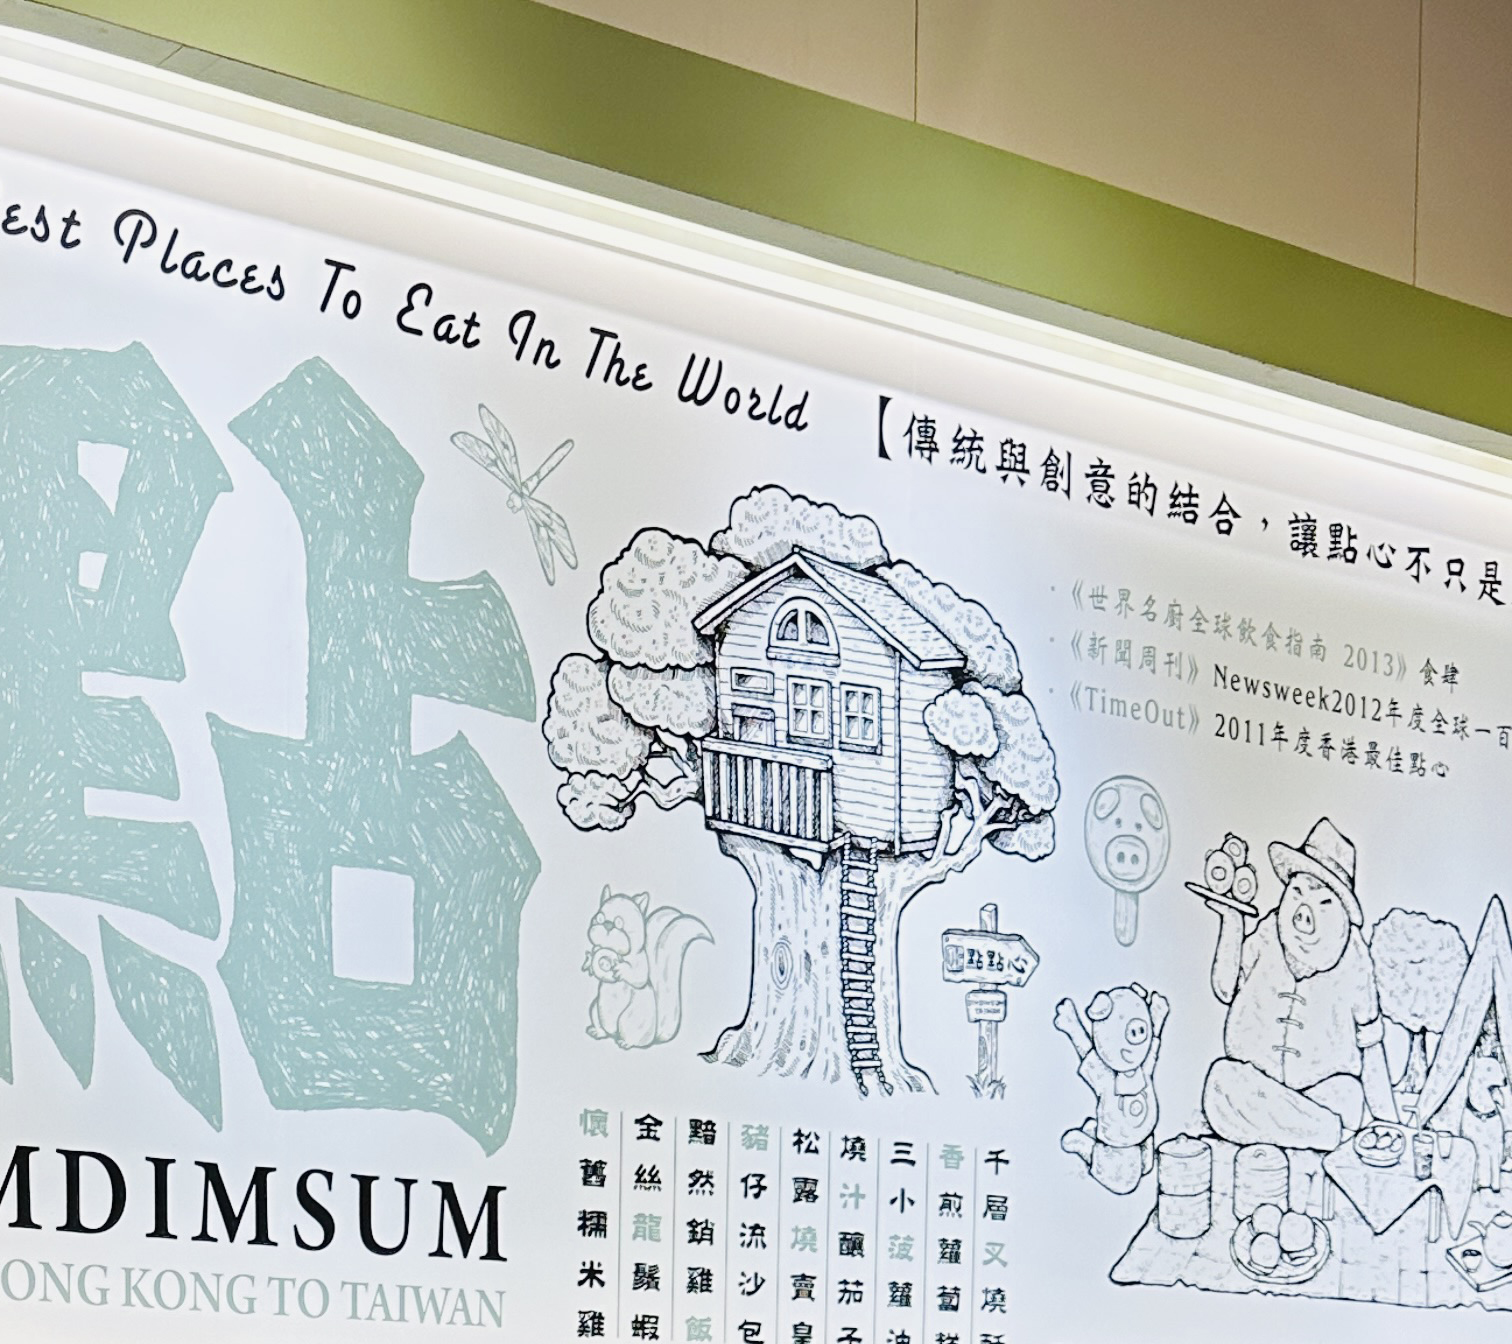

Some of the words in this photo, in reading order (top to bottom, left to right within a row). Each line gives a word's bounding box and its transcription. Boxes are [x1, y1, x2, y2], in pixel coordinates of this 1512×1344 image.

[113, 208, 286, 302] Places
[319, 258, 363, 321] To
[395, 282, 481, 350] Eat
[507, 309, 562, 370] In
[584, 326, 654, 392] The
[676, 352, 810, 433] World
[120, 1266, 258, 1315] KONG
[266, 1275, 330, 1320] TO
[339, 1279, 507, 1329] TAIWAN
